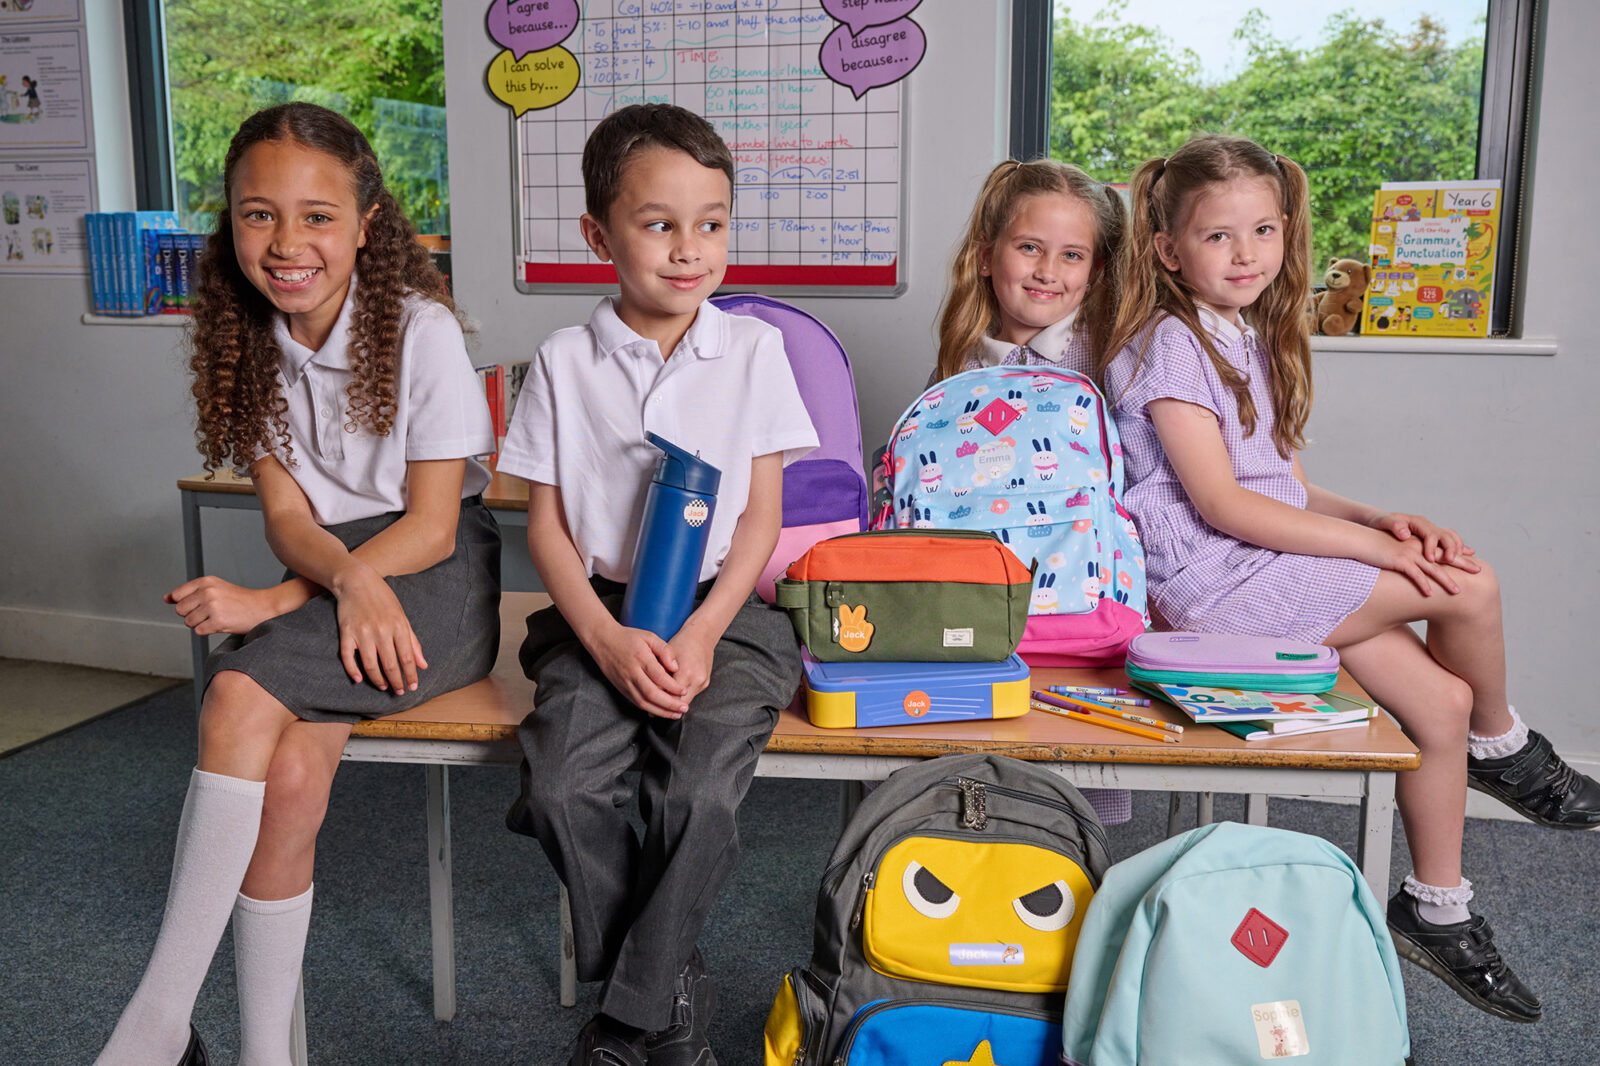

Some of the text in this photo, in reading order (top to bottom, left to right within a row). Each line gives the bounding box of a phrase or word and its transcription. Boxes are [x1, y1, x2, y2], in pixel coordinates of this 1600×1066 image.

[517, 2, 549, 17] agree
[508, 21, 568, 35] because...
[705, 19, 729, 28] and
[851, 31, 906, 49] disagree
[510, 63, 531, 73] can
[534, 57, 565, 71] solve
[841, 57, 909, 73] because...
[505, 77, 559, 94] this by...
[1448, 192, 1492, 208] Year 6
[1403, 234, 1456, 246] Grammar
[1397, 247, 1464, 258] Punctuation
[162, 249, 173, 297] Dictionary
[178, 249, 189, 297] Dictionary
[979, 454, 1011, 464] Emma
[844, 630, 865, 640] Jack
[907, 700, 926, 708] Jack
[958, 949, 989, 960] Jack
[1253, 1005, 1299, 1022] Sopie
